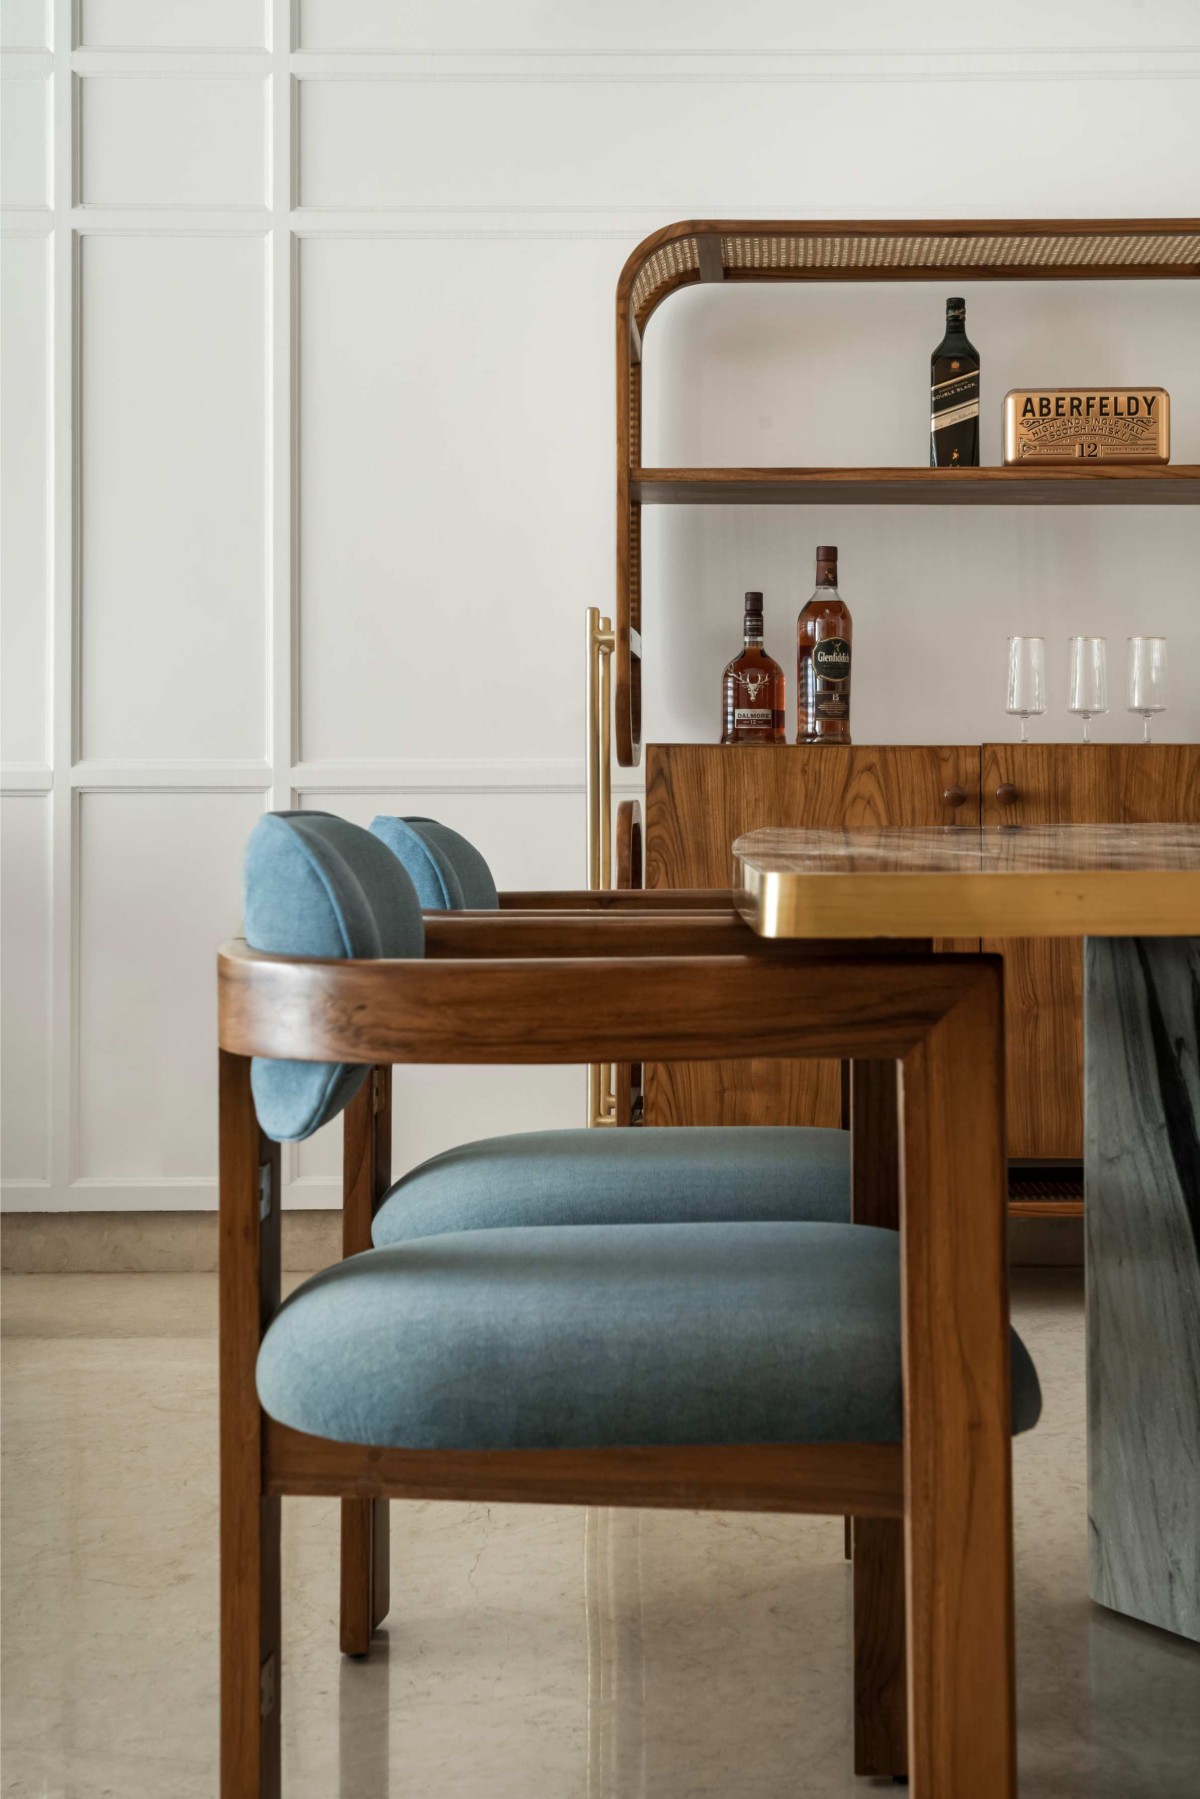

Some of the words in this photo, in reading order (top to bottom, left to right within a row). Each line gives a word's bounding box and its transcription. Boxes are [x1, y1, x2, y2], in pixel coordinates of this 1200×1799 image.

[932, 389, 955, 401] DOUBLE
[956, 382, 975, 392] BLACK
[1022, 395, 1157, 417] ABERFELDY
[1032, 418, 1080, 438] HIGHLAND
[1084, 417, 1119, 427] SINGLE
[1123, 422, 1146, 436] MALT
[1048, 425, 1087, 439] SCOTCH
[1091, 425, 1127, 438] WHISKY
[1078, 443, 1098, 457] 12
[817, 651, 850, 663] Glenfiddich
[832, 693, 840, 701] 15
